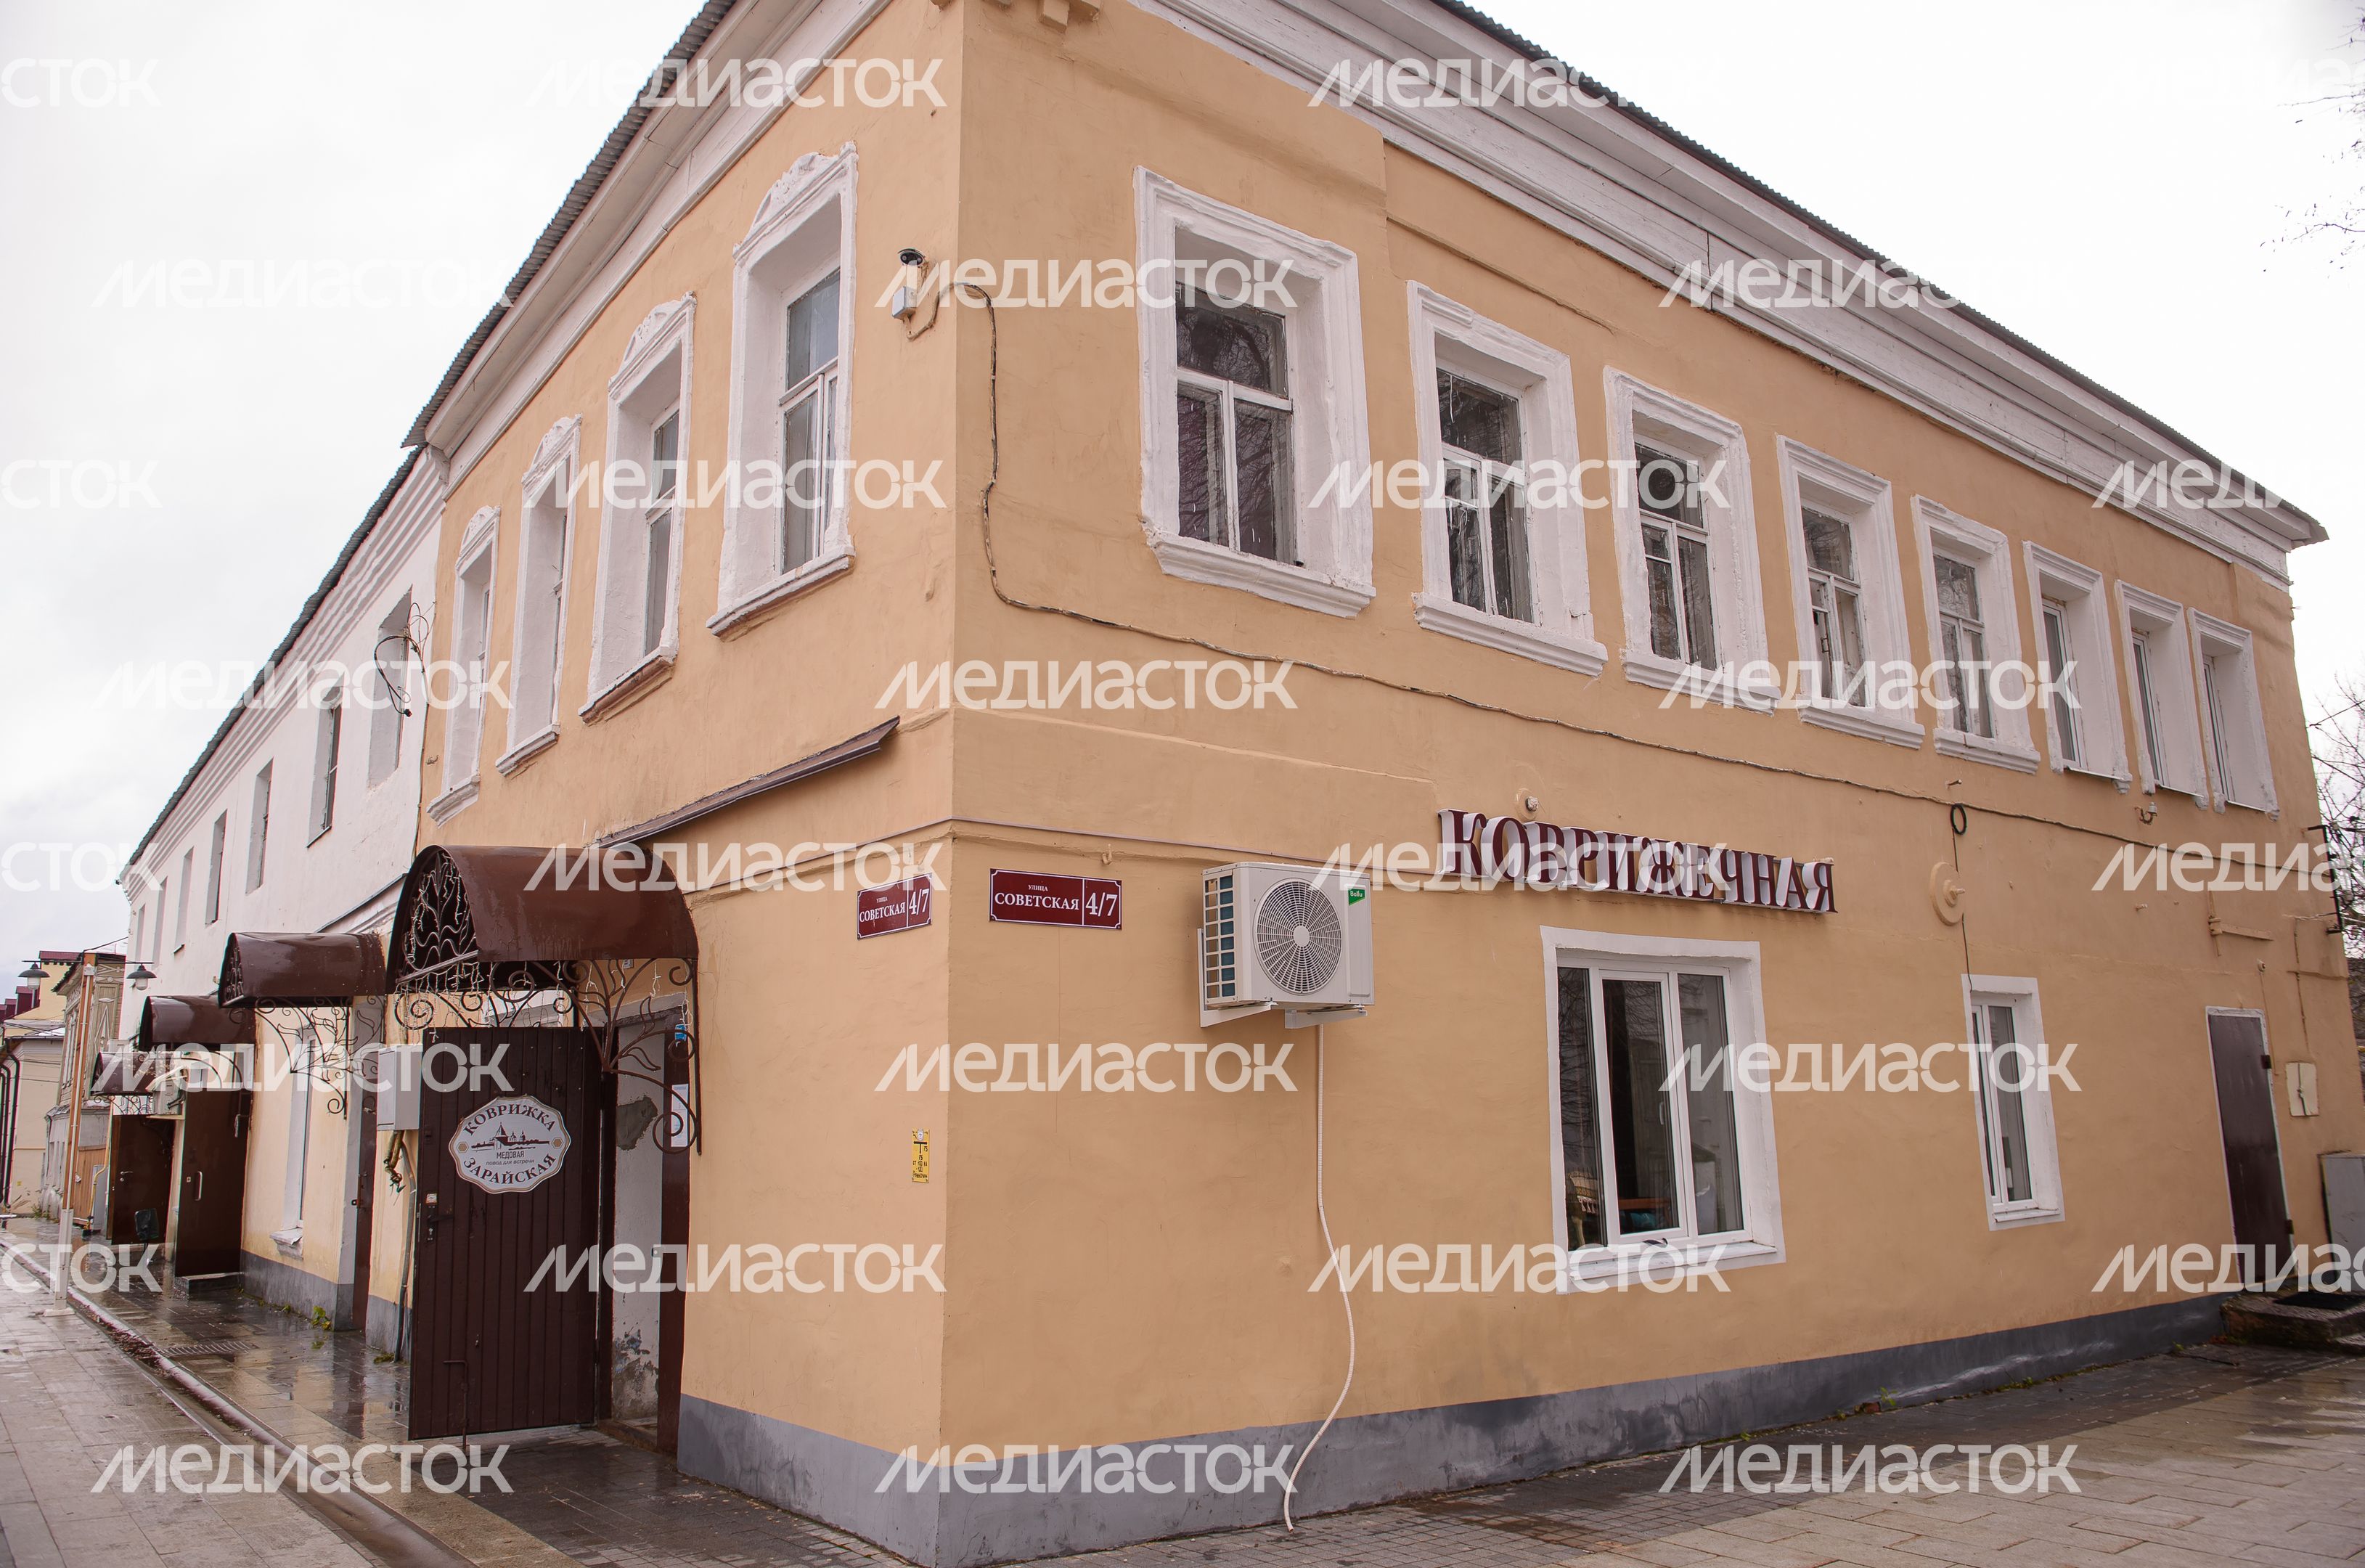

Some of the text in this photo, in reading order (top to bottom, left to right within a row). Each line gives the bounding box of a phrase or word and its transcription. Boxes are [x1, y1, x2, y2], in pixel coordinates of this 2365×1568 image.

[1437, 808, 1838, 914] КОВРИЖЕЧНАЯ
[859, 888, 929, 923] СОВЕТСКАЯ 4/7
[994, 892, 1118, 917] СОВЕТСКАЯ 4/7
[463, 1104, 555, 1135] КОВРИЖКА
[463, 1154, 556, 1184] ЗАРАЙСКАЯ
